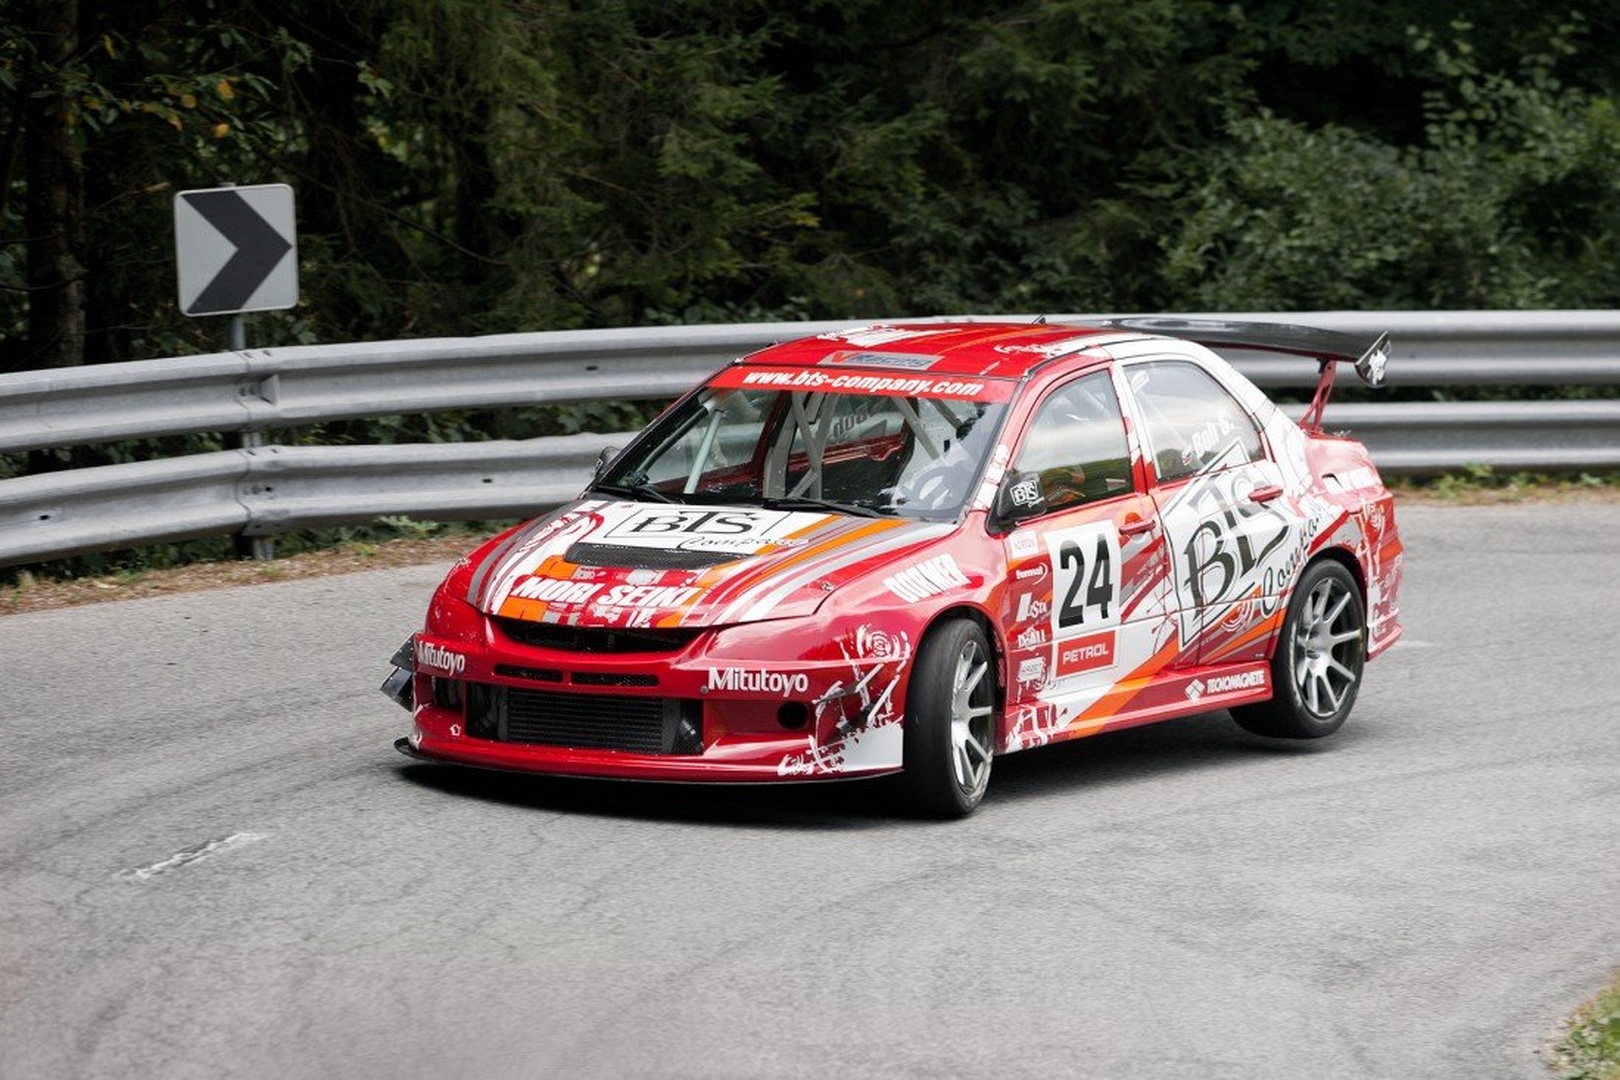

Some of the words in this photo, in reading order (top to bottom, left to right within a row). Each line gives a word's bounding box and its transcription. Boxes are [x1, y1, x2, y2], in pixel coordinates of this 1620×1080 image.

[743, 370, 984, 397] www.bts-company.com
[1013, 482, 1037, 503] BTS
[629, 510, 758, 535] BTS
[511, 577, 604, 604] MORI
[597, 585, 703, 608] SEIKI
[1058, 533, 1115, 628] 24
[417, 641, 466, 676] Mitutoyo
[1062, 641, 1110, 664] PETROL
[707, 667, 808, 697] Mitutoyo
